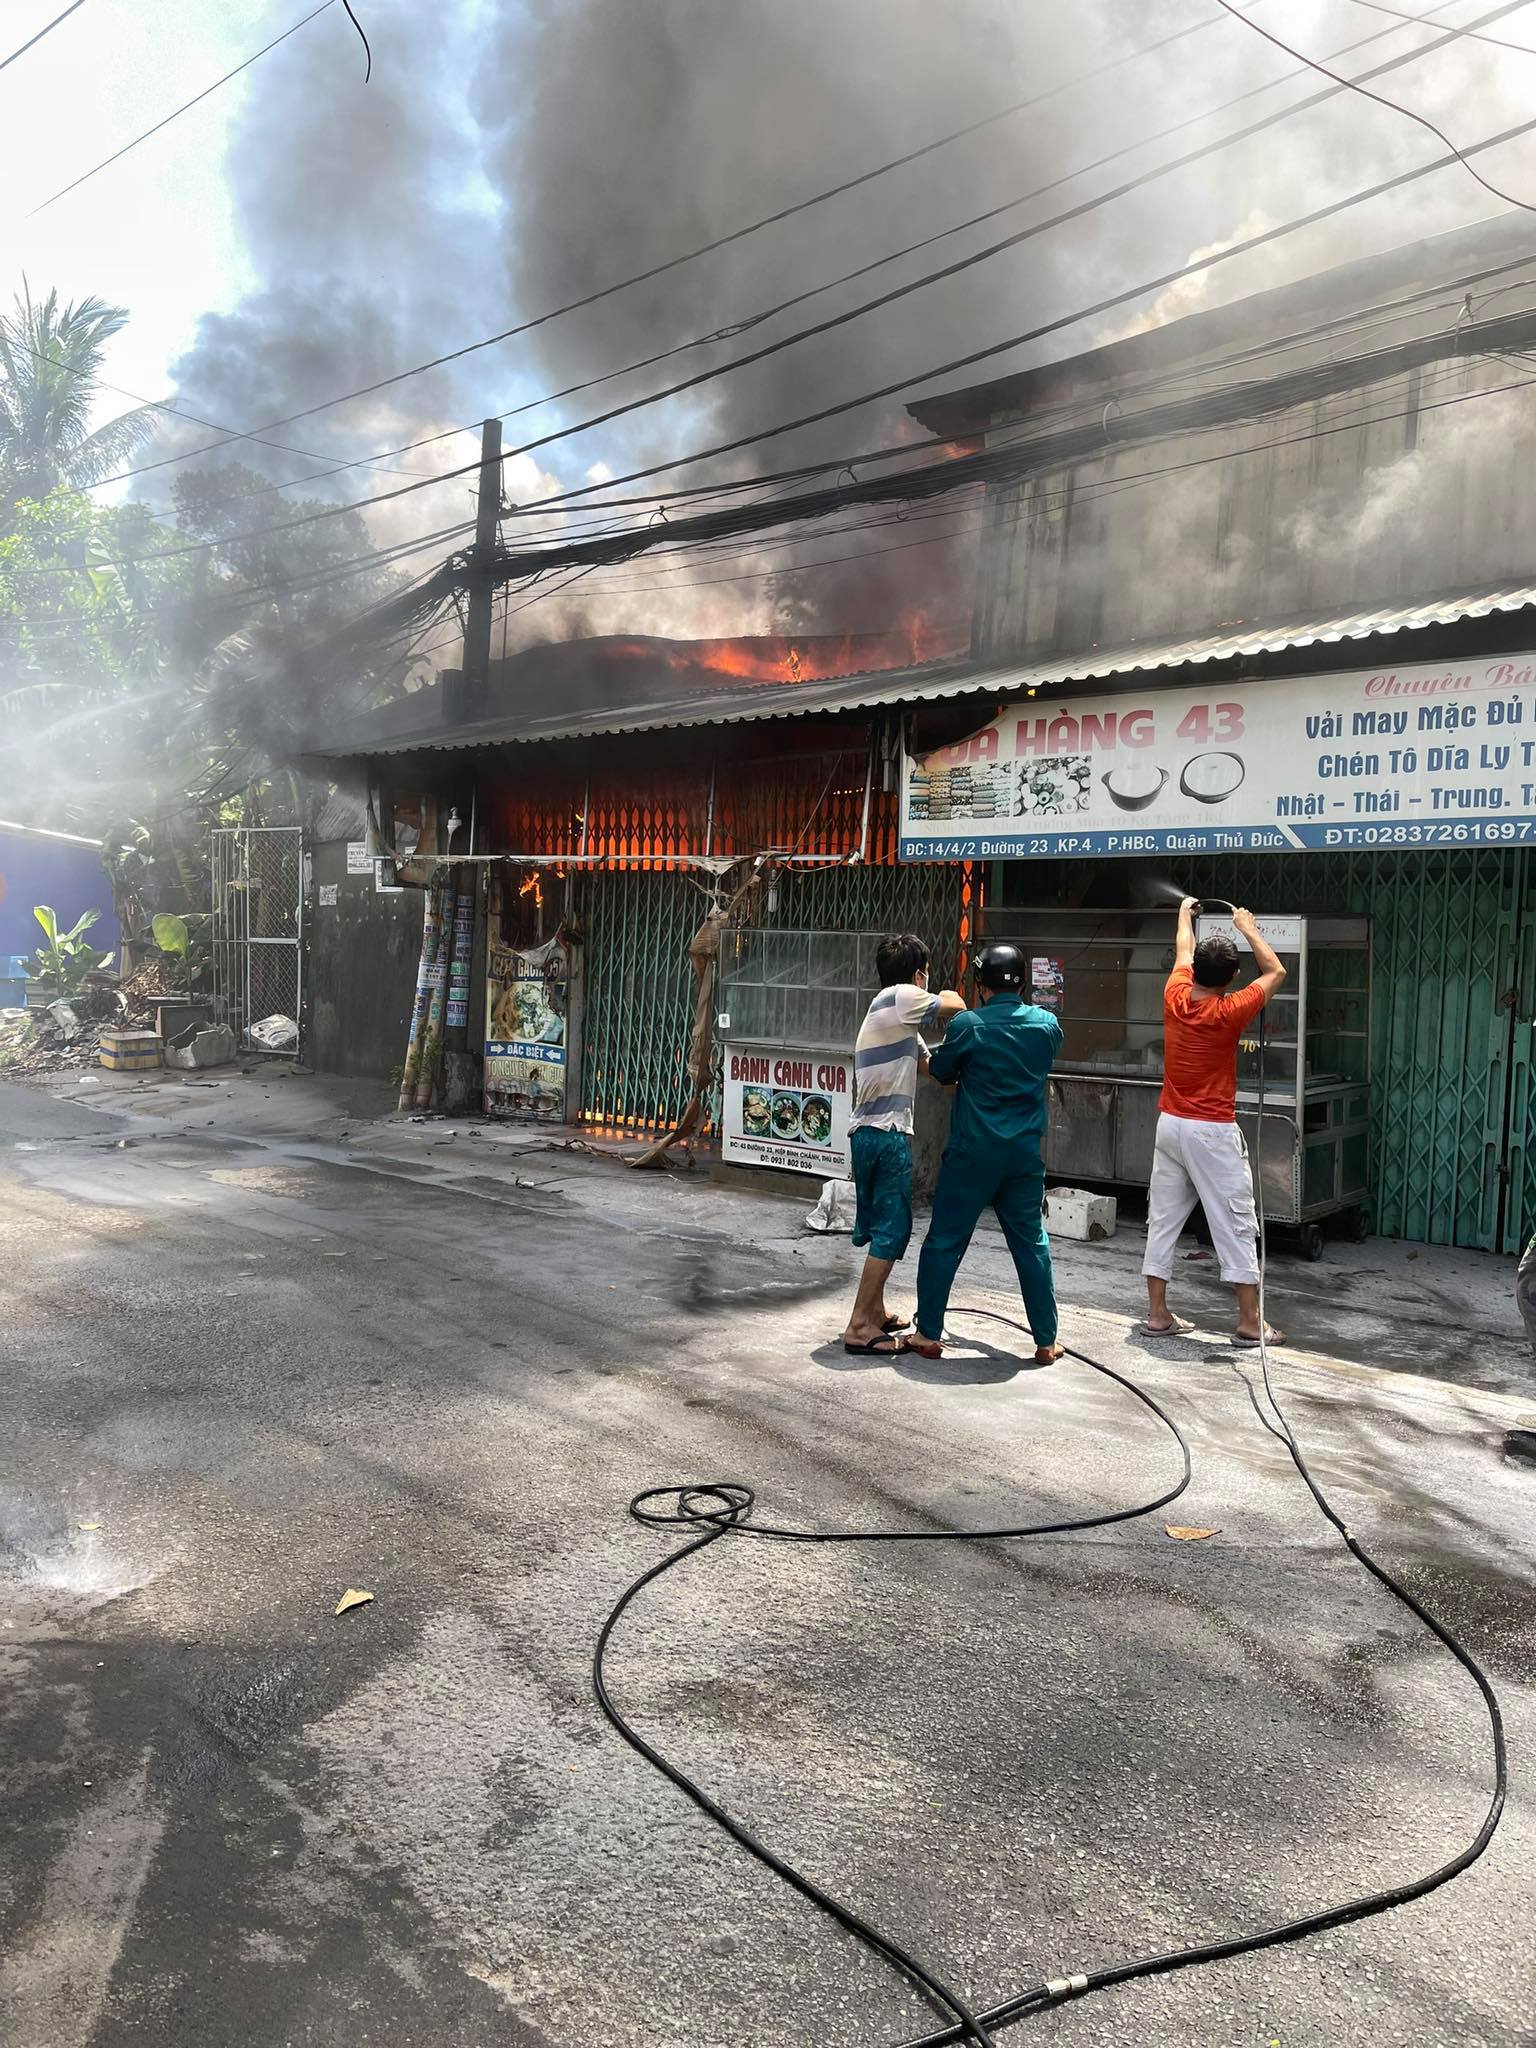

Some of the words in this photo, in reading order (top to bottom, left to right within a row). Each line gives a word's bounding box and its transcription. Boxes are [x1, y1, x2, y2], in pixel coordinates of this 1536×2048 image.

[1365, 672, 1472, 697] Chuyên
[1486, 663, 1536, 686] Bá
[1016, 708, 1155, 757] HÀNG
[1176, 702, 1245, 745] 43
[1305, 710, 1342, 739] Vải
[1352, 711, 1408, 736] May
[1418, 702, 1476, 734] Mặc
[1486, 695, 1523, 725] Đủ
[1318, 751, 1379, 778] Chén
[1389, 747, 1417, 774] Tô
[1427, 745, 1469, 772] Dĩa
[1480, 744, 1510, 770] Ly
[1277, 793, 1324, 819] Nhật
[1353, 789, 1400, 813] Thái
[1431, 786, 1510, 809] Trung.
[906, 842, 976, 856] ĐC:14/4/2
[981, 841, 1025, 857] Đường
[1030, 839, 1048, 854] 23
[1166, 833, 1206, 851] Quận
[1214, 831, 1243, 848] Thủ
[1251, 832, 1284, 847] Đức
[507, 1043, 524, 1057] ĐẶC
[526, 1046, 544, 1060] BIỆT
[731, 1048, 770, 1084] BÁNH
[774, 1060, 812, 1089] CANH
[817, 1064, 847, 1093] CUA
